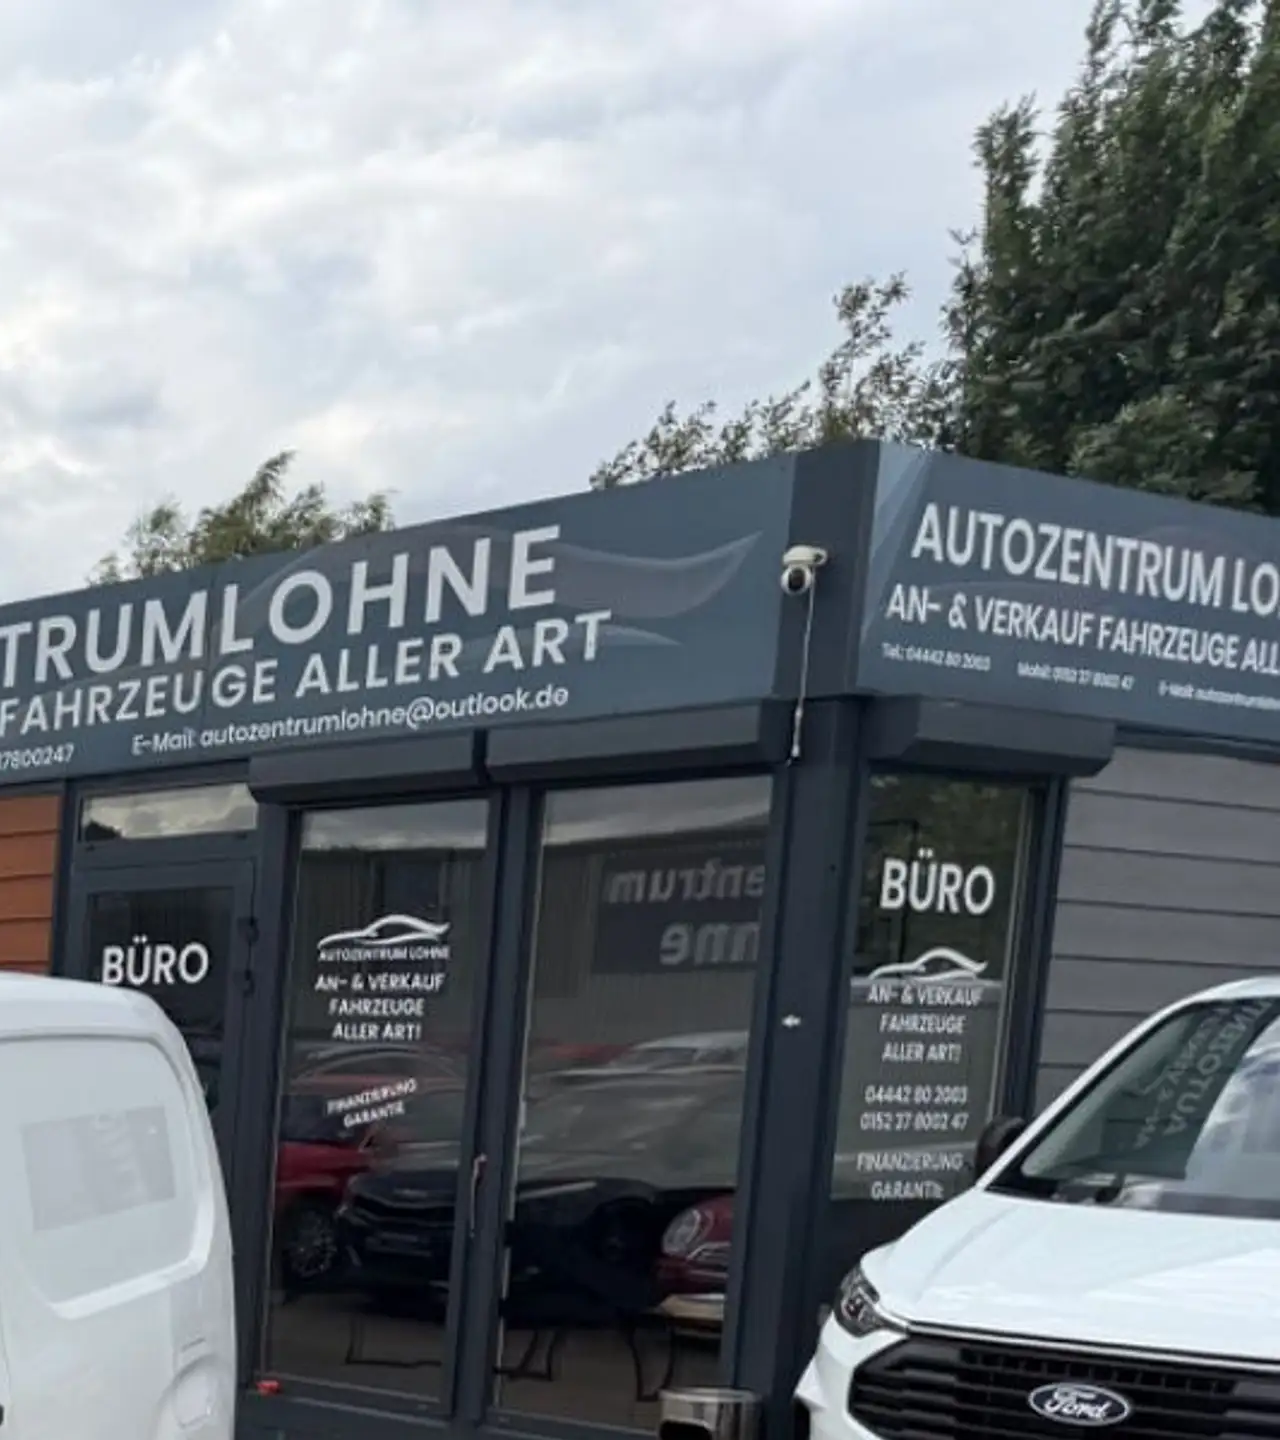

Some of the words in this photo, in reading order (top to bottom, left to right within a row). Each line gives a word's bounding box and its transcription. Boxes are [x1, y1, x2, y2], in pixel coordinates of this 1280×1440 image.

[911, 502, 1226, 608] AUTOZENTRUM
[1232, 558, 1280, 619] LO
[885, 583, 941, 624] AN-
[948, 592, 967, 629] &
[975, 595, 1095, 648] VERKAUF
[1097, 615, 1239, 669] FAHRZEUGE
[295, 633, 462, 698] ALLER
[483, 609, 612, 674] ART
[200, 684, 569, 746] autozentrumlohne@outlook.de
[880, 847, 995, 914] BÜRO
[102, 934, 209, 986] BÜRO
[314, 974, 347, 991] AN-
[351, 972, 364, 991] &
[367, 971, 445, 992] VERKAUF
[900, 983, 914, 1004] &
[917, 985, 985, 1006] VERKAUF
[328, 997, 425, 1017] FAHRZEUGE
[332, 1021, 379, 1040] ALLER
[382, 1021, 422, 1041] ART!
[879, 1013, 967, 1034] FAHRZEUGE
[881, 1042, 925, 1063] ALLER
[856, 1151, 965, 1171] FINANZIERUNG
[1043, 1389, 1113, 1421] Ford
